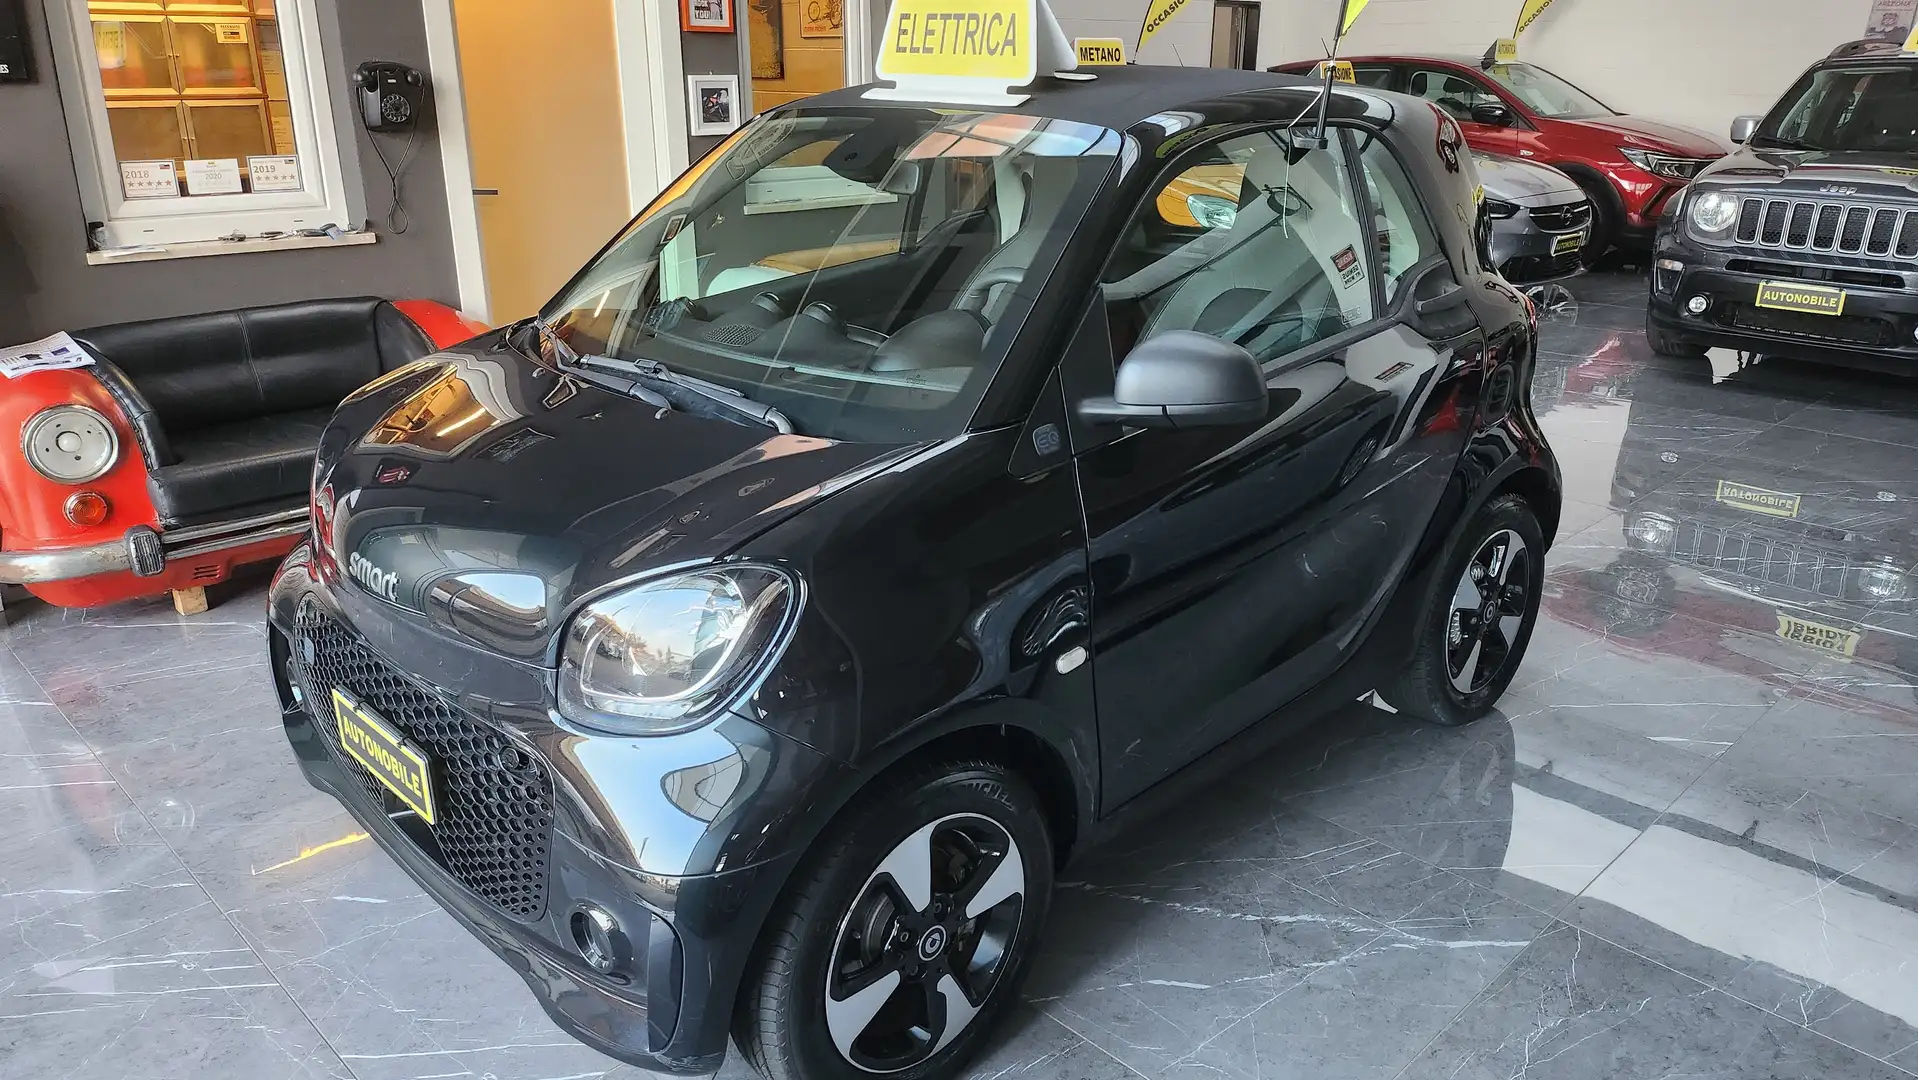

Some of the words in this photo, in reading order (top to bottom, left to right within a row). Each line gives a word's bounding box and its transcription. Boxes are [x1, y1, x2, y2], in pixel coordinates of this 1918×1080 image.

[896, 12, 1016, 56] ELETTRICA
[1080, 47, 1121, 62] METANO
[125, 170, 150, 179] 2018
[205, 172, 222, 180] 2020
[252, 165, 276, 174] 2019
[1820, 183, 1858, 196] Jeep
[1763, 290, 1838, 307] AUTONOBILE
[349, 551, 398, 602] smart
[343, 715, 422, 799] AUTONOBILE
